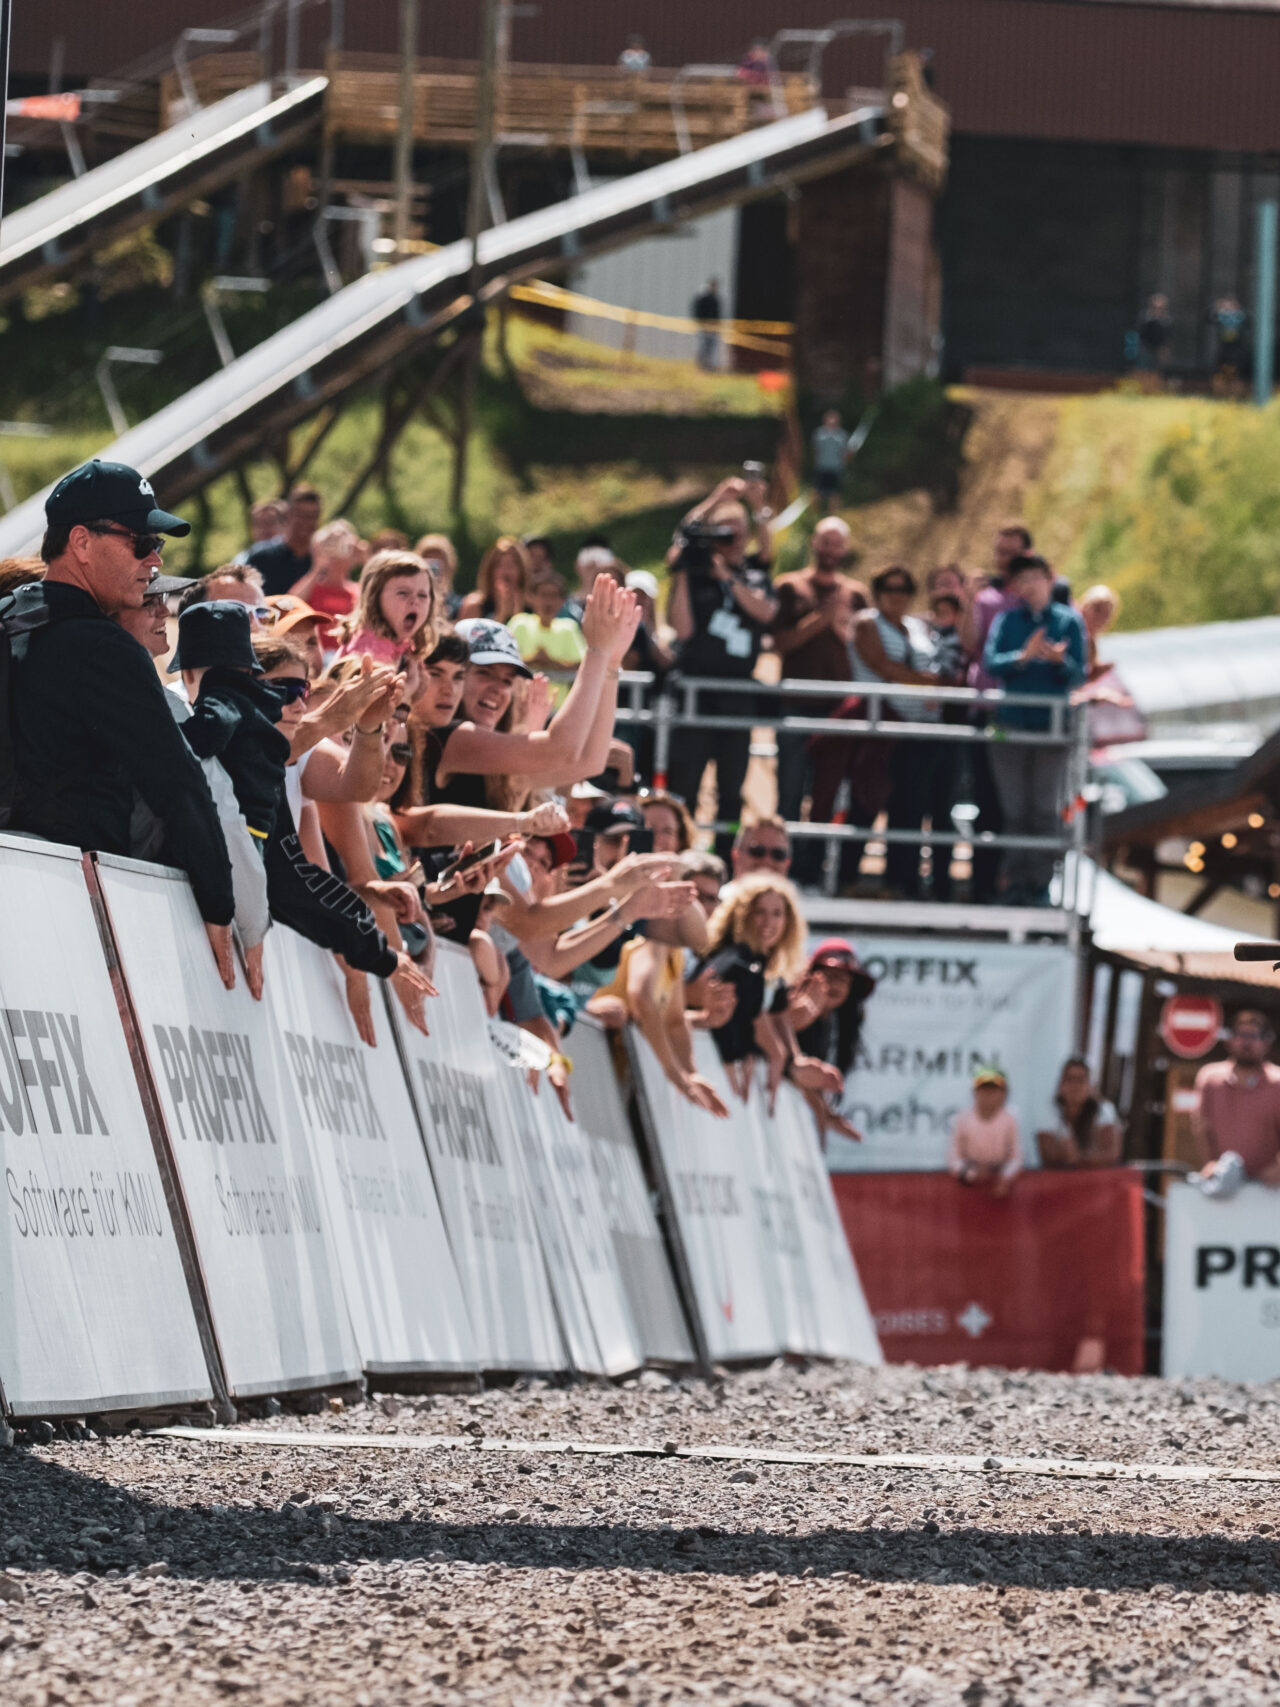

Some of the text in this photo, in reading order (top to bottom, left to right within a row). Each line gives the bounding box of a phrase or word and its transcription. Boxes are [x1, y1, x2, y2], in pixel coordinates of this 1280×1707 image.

[862, 955, 980, 987] OFFIX
[0, 1008, 110, 1137] OFFIX
[152, 1023, 277, 1145] PROFFIX
[284, 1030, 387, 1143] PROFFIX
[418, 1058, 503, 1168] PROFFIX
[853, 1045, 1001, 1075] ARMIN
[5, 1167, 163, 1238] Software für KMU
